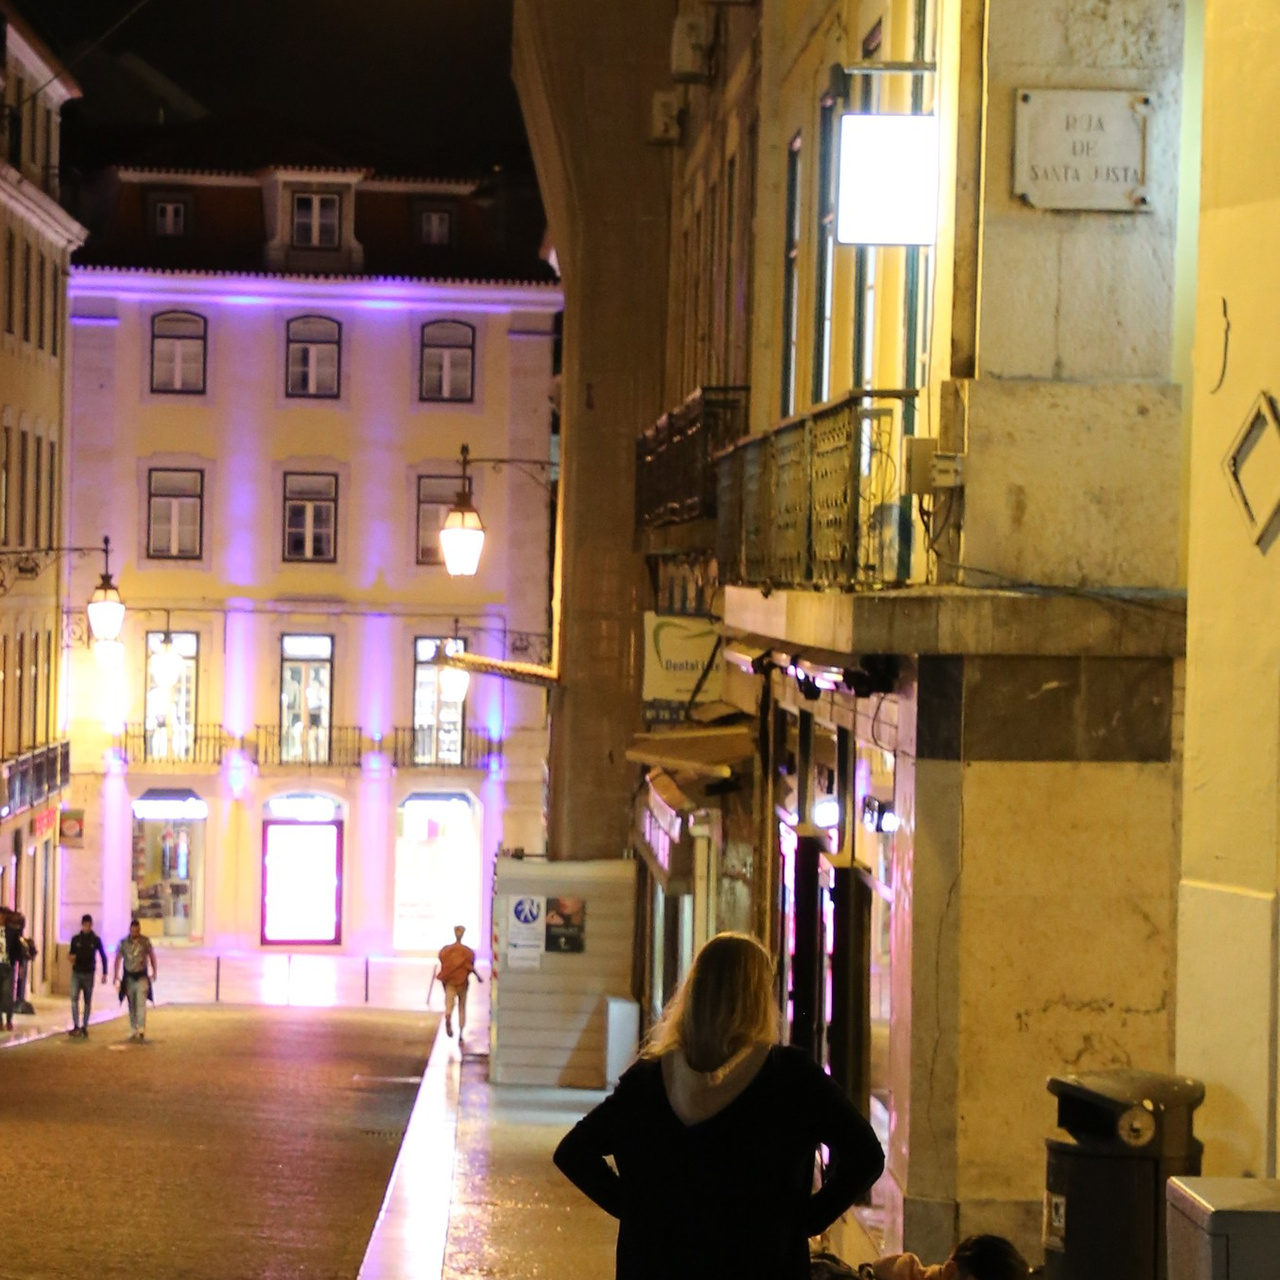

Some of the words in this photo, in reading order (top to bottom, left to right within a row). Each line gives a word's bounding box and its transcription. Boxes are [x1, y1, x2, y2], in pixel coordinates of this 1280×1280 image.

[1065, 113, 1104, 132] RUA
[1071, 140, 1097, 157] DE
[1030, 164, 1080, 182] SANTA
[1093, 166, 1139, 183] JUSTA
[665, 659, 699, 672] Dental
